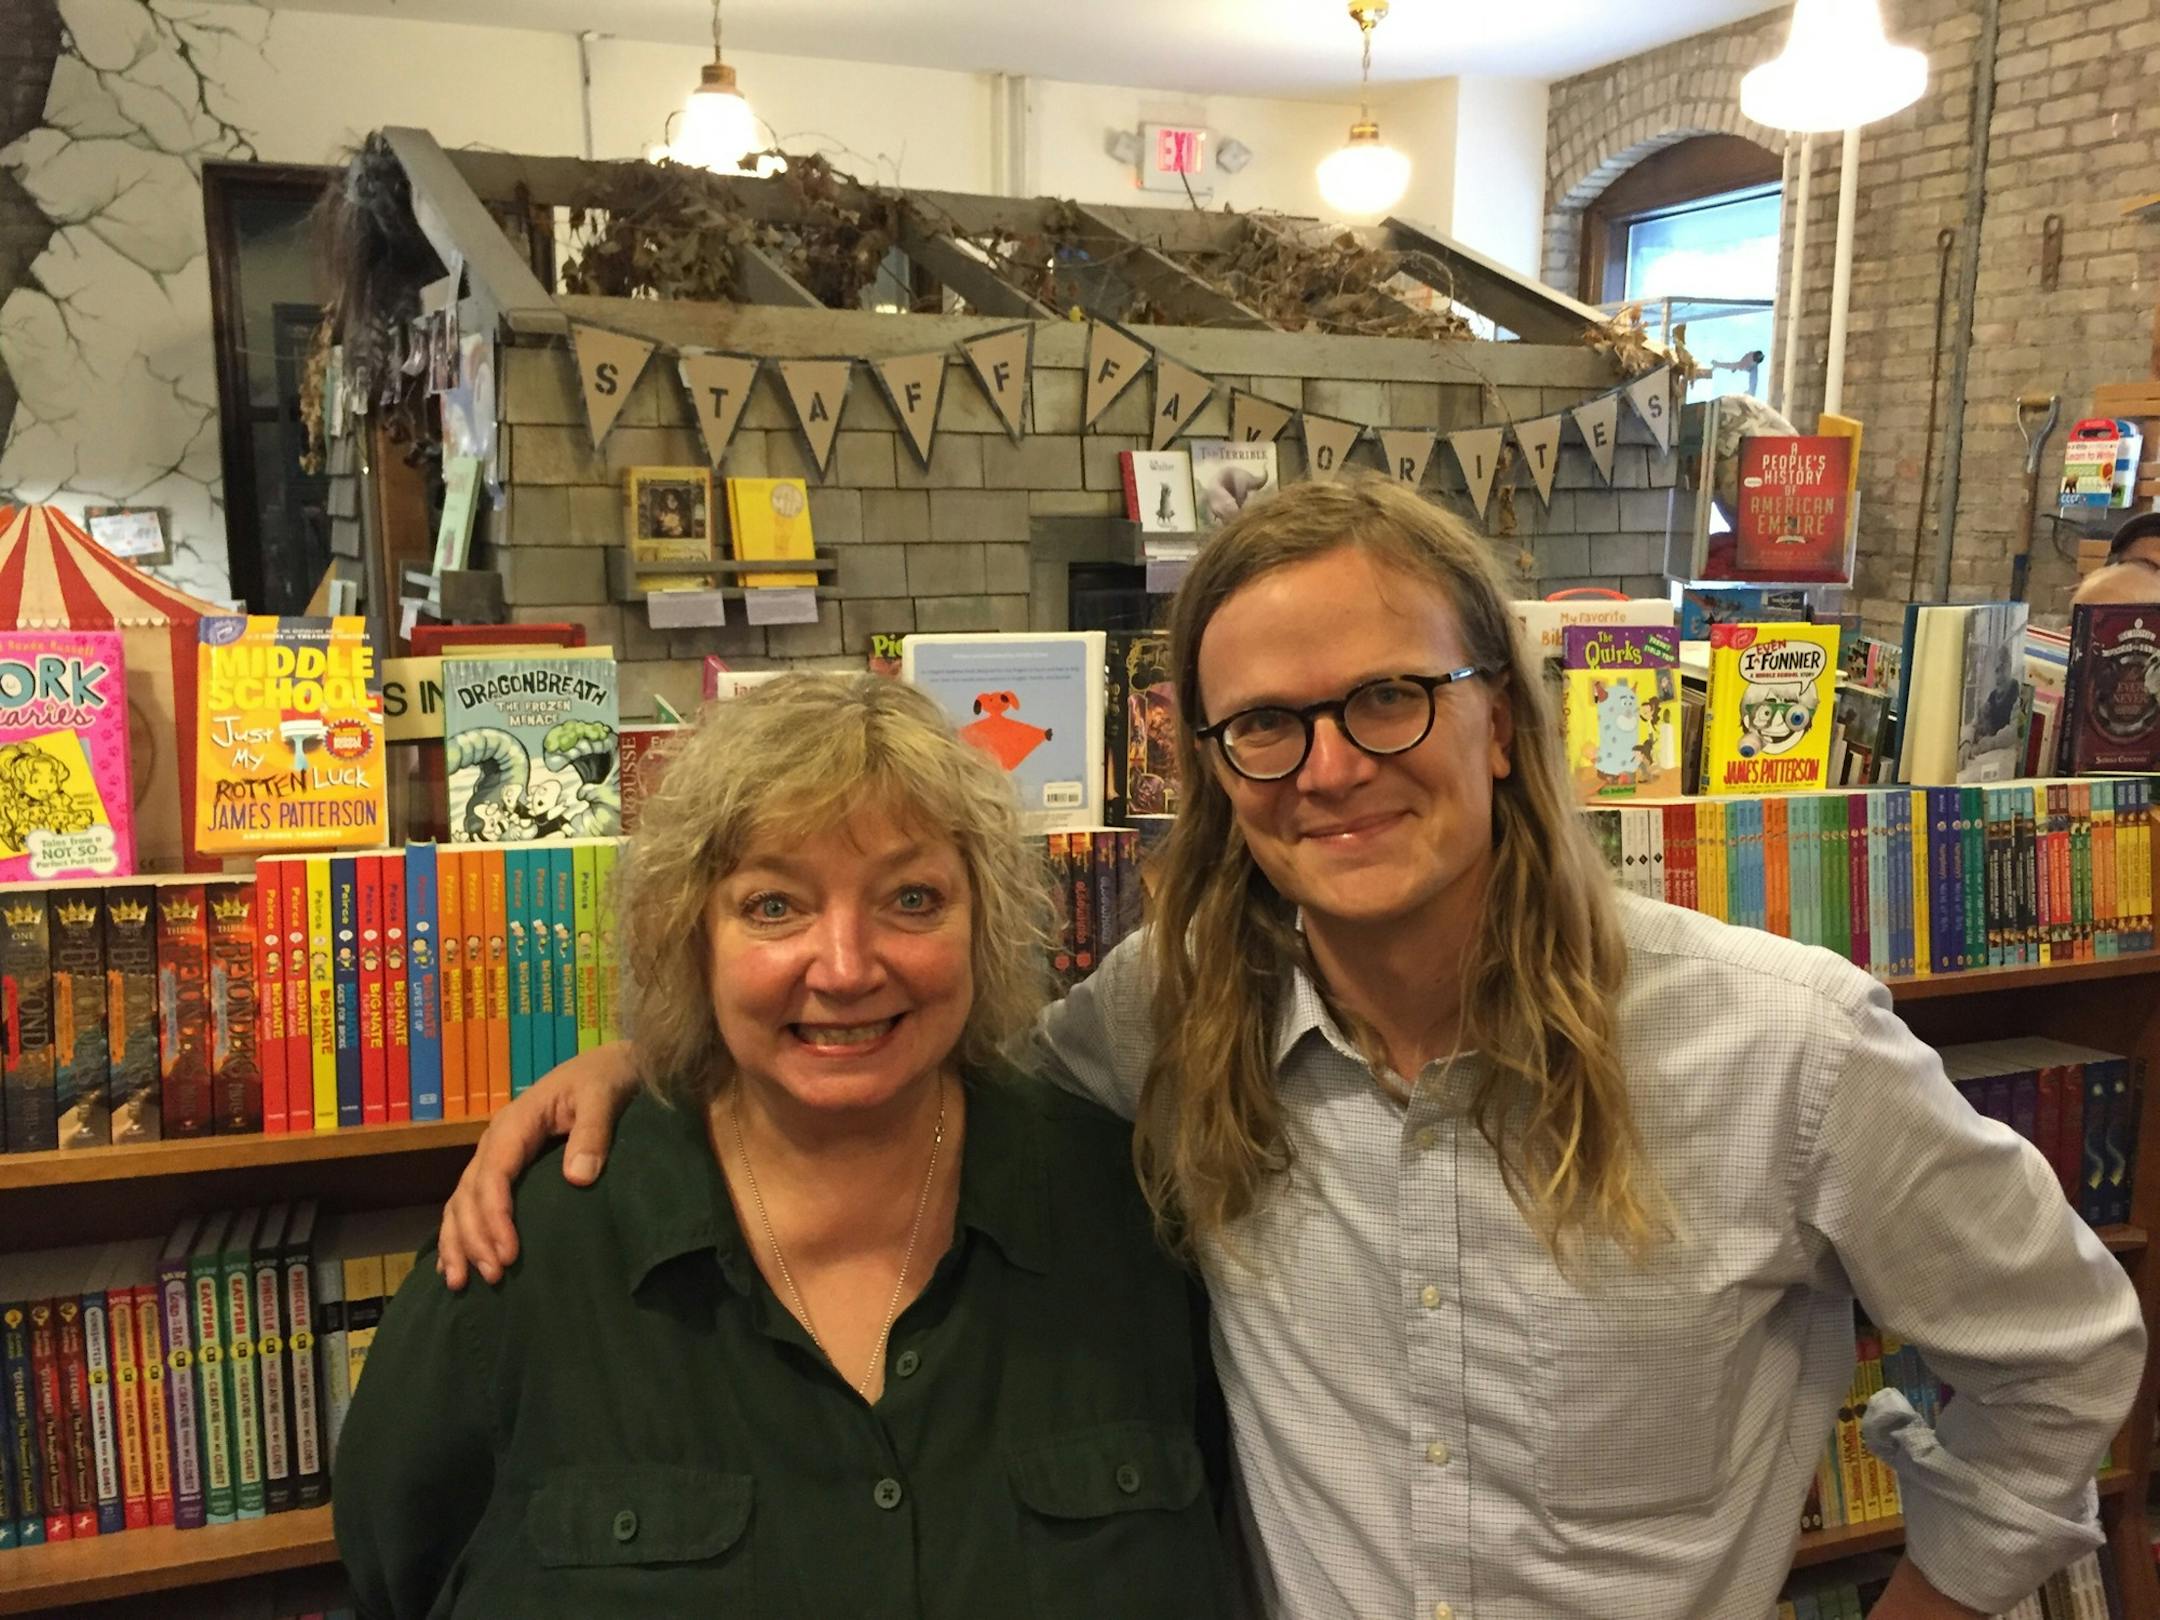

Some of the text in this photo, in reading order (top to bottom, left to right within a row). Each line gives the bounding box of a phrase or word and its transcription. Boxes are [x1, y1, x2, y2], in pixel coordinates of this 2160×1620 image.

[1762, 454, 1826, 471] PEOPLE'S
[1790, 442, 1798, 456] A
[1764, 469, 1824, 486] HISTORY
[1784, 485, 1797, 496] OF
[1750, 496, 1834, 514] AMERICAN
[1757, 514, 1825, 535] EMPIRE
[1597, 630, 1614, 644] The
[1756, 638, 1787, 656] EVEN
[211, 645, 376, 680] MIDDLE
[1585, 640, 1643, 671] Quirks
[1744, 650, 1822, 671] I FUNNIER
[0, 656, 106, 708] ORK
[207, 676, 379, 714] SCHOOL
[457, 670, 608, 710] DRAGONBREATH
[496, 699, 572, 713] THE FROZEN
[508, 713, 558, 727] MENACE
[212, 715, 274, 751] Just
[231, 748, 265, 773] My
[1723, 757, 1820, 785] JAMES PATTERSON
[215, 765, 371, 802] ROTTEN LUCK
[207, 799, 378, 833] JAMES PATTERSON
[341, 883, 350, 925] Peirce
[271, 982, 284, 1039] BIG NATE
[295, 979, 308, 1036] BIG NATE
[320, 988, 333, 1055] BIG NATE
[369, 983, 383, 1049] BIG NATE
[394, 980, 407, 1047] BIG NATE
